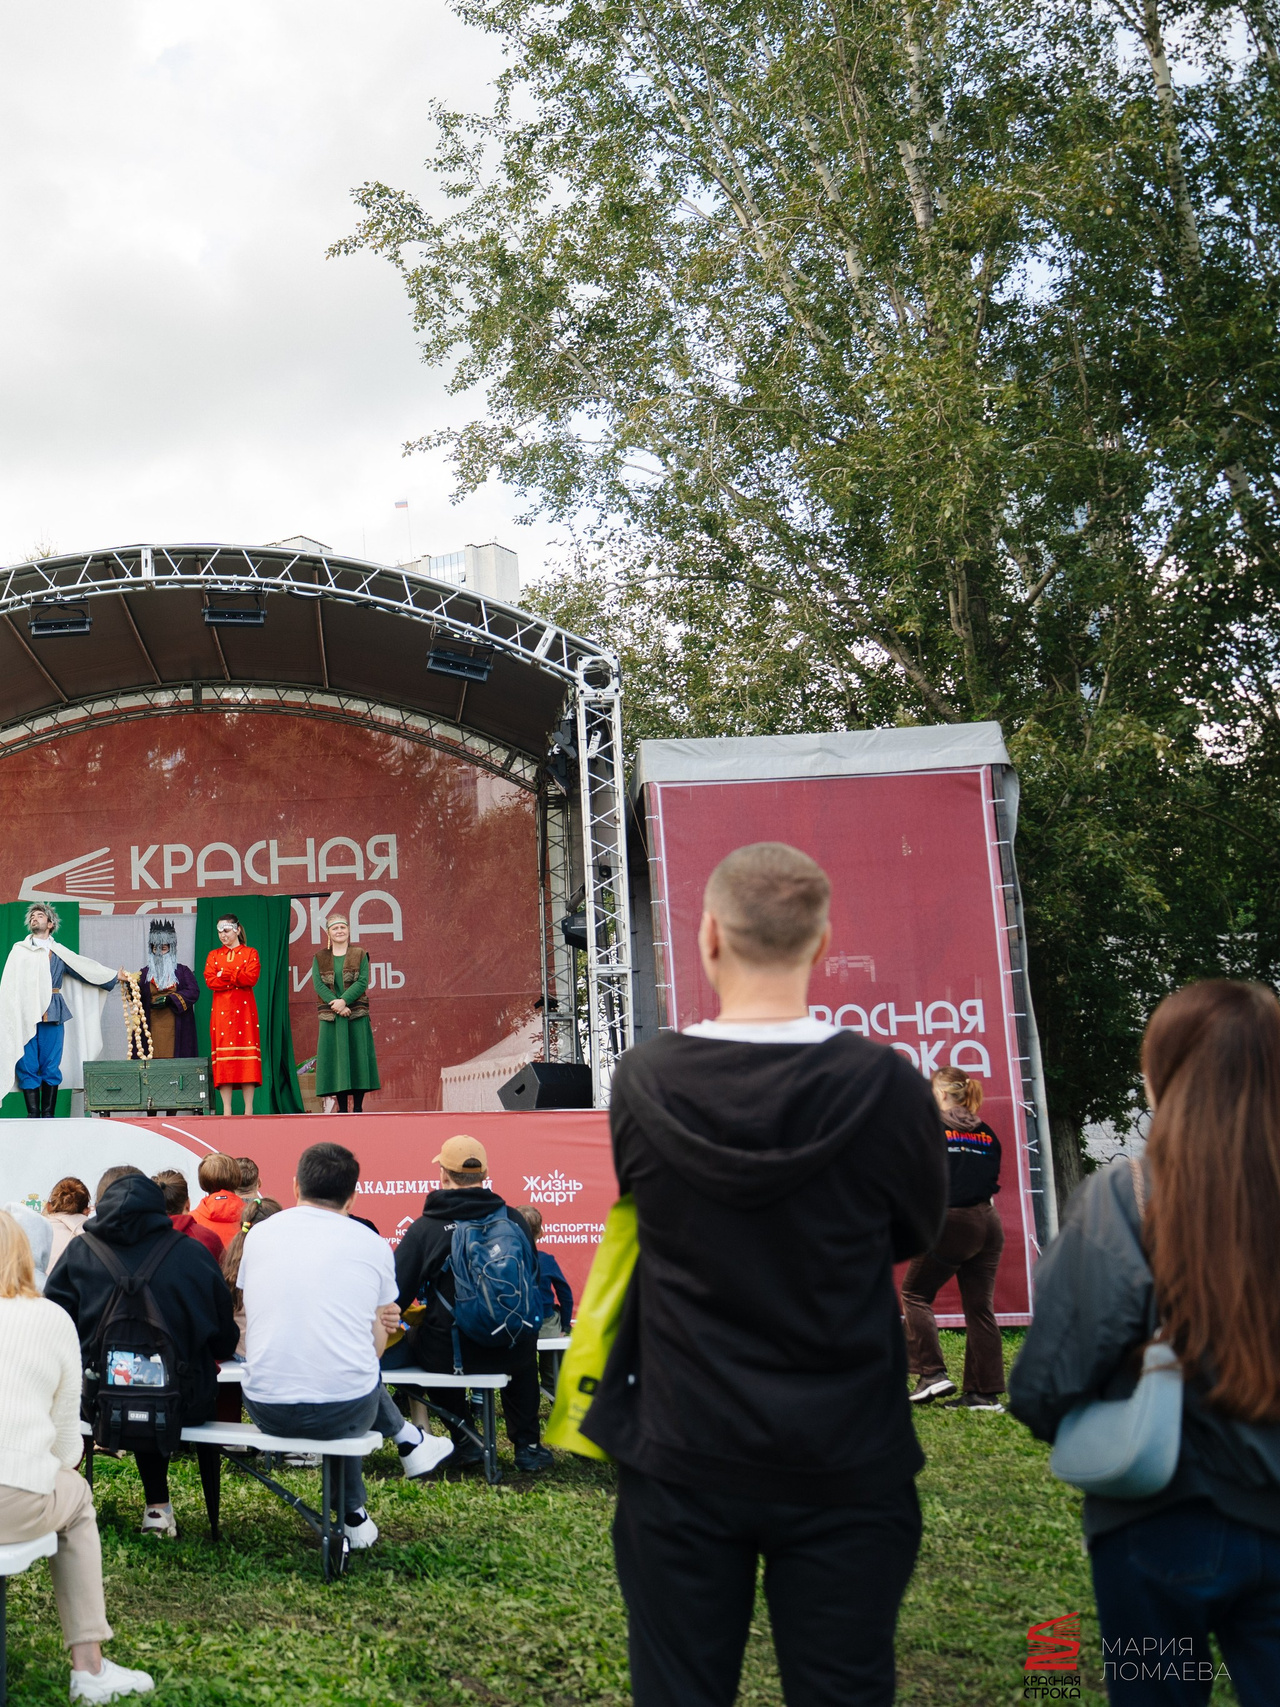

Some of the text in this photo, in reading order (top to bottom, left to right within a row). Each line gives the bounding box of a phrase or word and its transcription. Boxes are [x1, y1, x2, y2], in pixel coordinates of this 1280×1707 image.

[130, 834, 398, 891] КРАСНАЯ
[809, 999, 985, 1037] РАСНАЯ
[522, 1175, 583, 1191] Жизнь
[530, 1191, 577, 1206] март
[536, 1234, 588, 1244] МПАНИЯ
